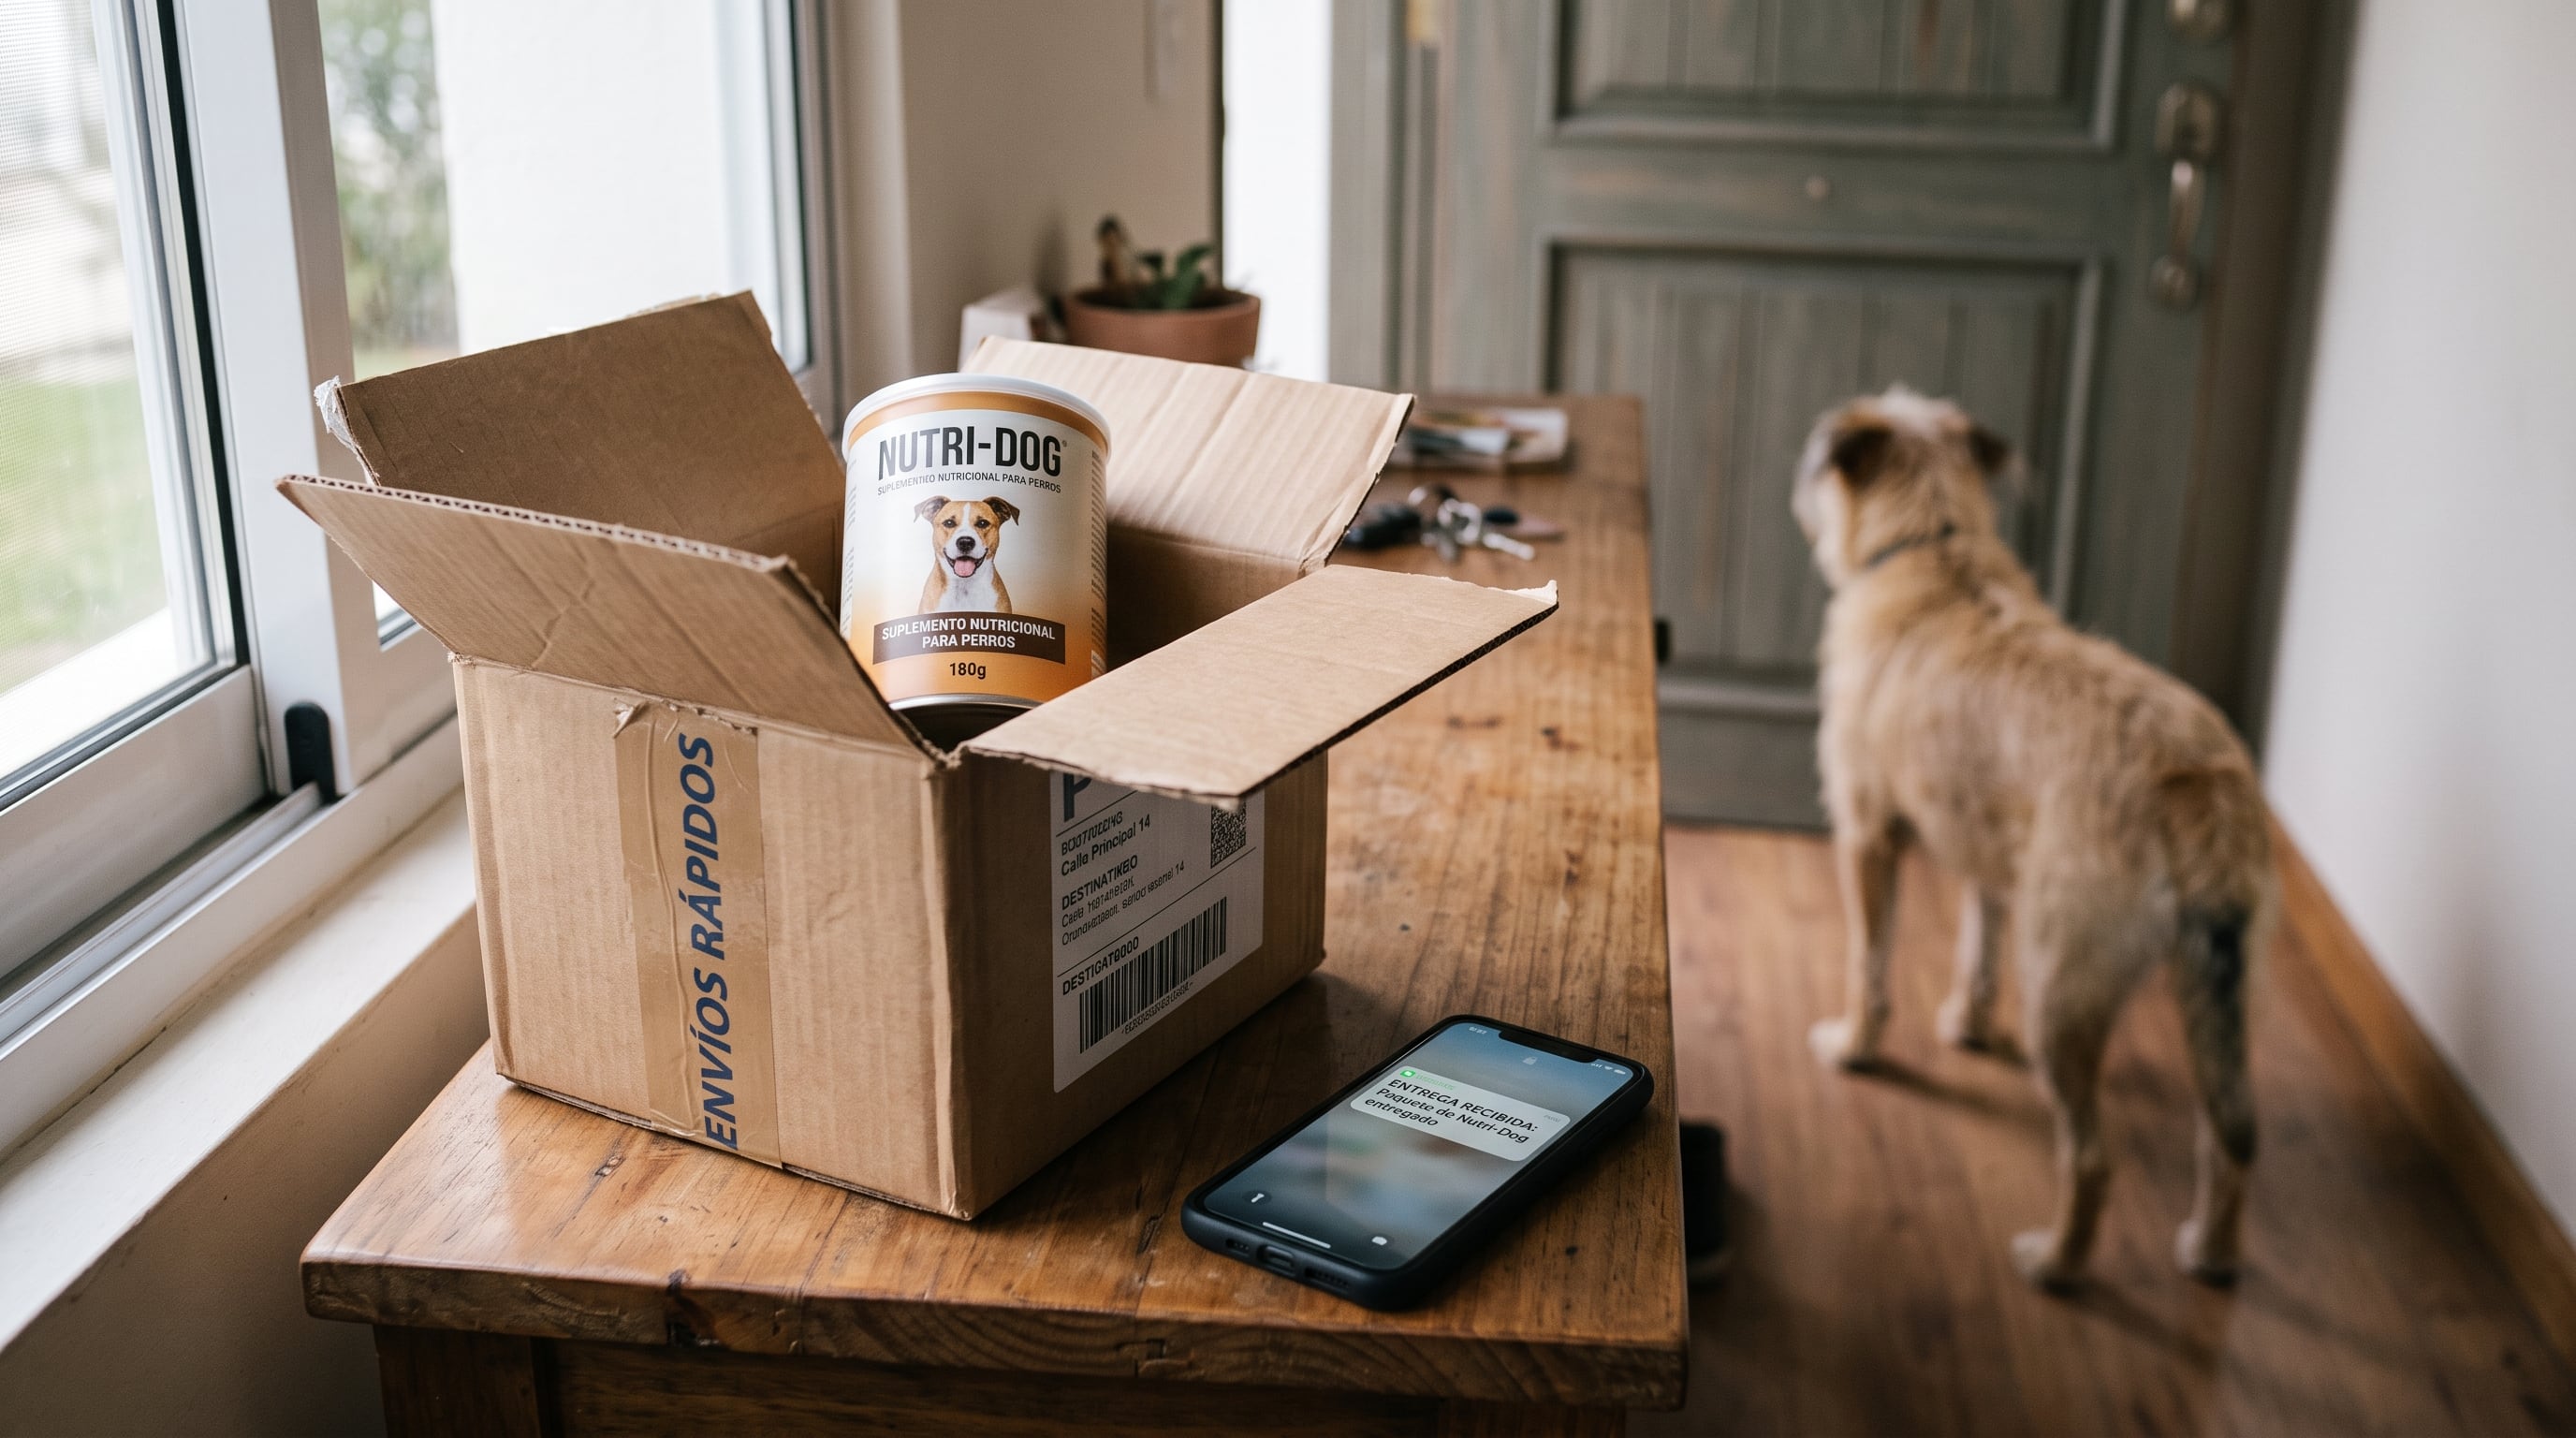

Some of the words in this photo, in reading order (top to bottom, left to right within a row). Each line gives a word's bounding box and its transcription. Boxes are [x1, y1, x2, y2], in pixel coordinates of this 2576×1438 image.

[878, 426, 1061, 480] NUTRI-DOG
[938, 472, 1001, 482] NUTRICIONAL
[1003, 474, 1027, 486] PARA
[1029, 477, 1061, 493] PERROS
[882, 618, 967, 640] SUPLEMENTO
[970, 618, 1056, 640] NUTRICIONAL
[922, 634, 958, 649] PARA
[961, 634, 1016, 648] PERROS
[949, 662, 987, 680] 180g
[678, 733, 725, 961] RÁPIDOS
[1061, 853, 1089, 876] Calle
[1091, 822, 1136, 860] Principal
[1139, 814, 1150, 832] 14
[690, 967, 739, 1151] ENVÍOS
[1365, 1098, 1439, 1126] entregado
[1376, 1088, 1435, 1112] Paquete
[1436, 1108, 1456, 1119] de
[1456, 1114, 1530, 1144] Nutri-Dog
[1387, 1078, 1460, 1107] ENTREGA
[1460, 1102, 1538, 1132] RECIBIDA:
